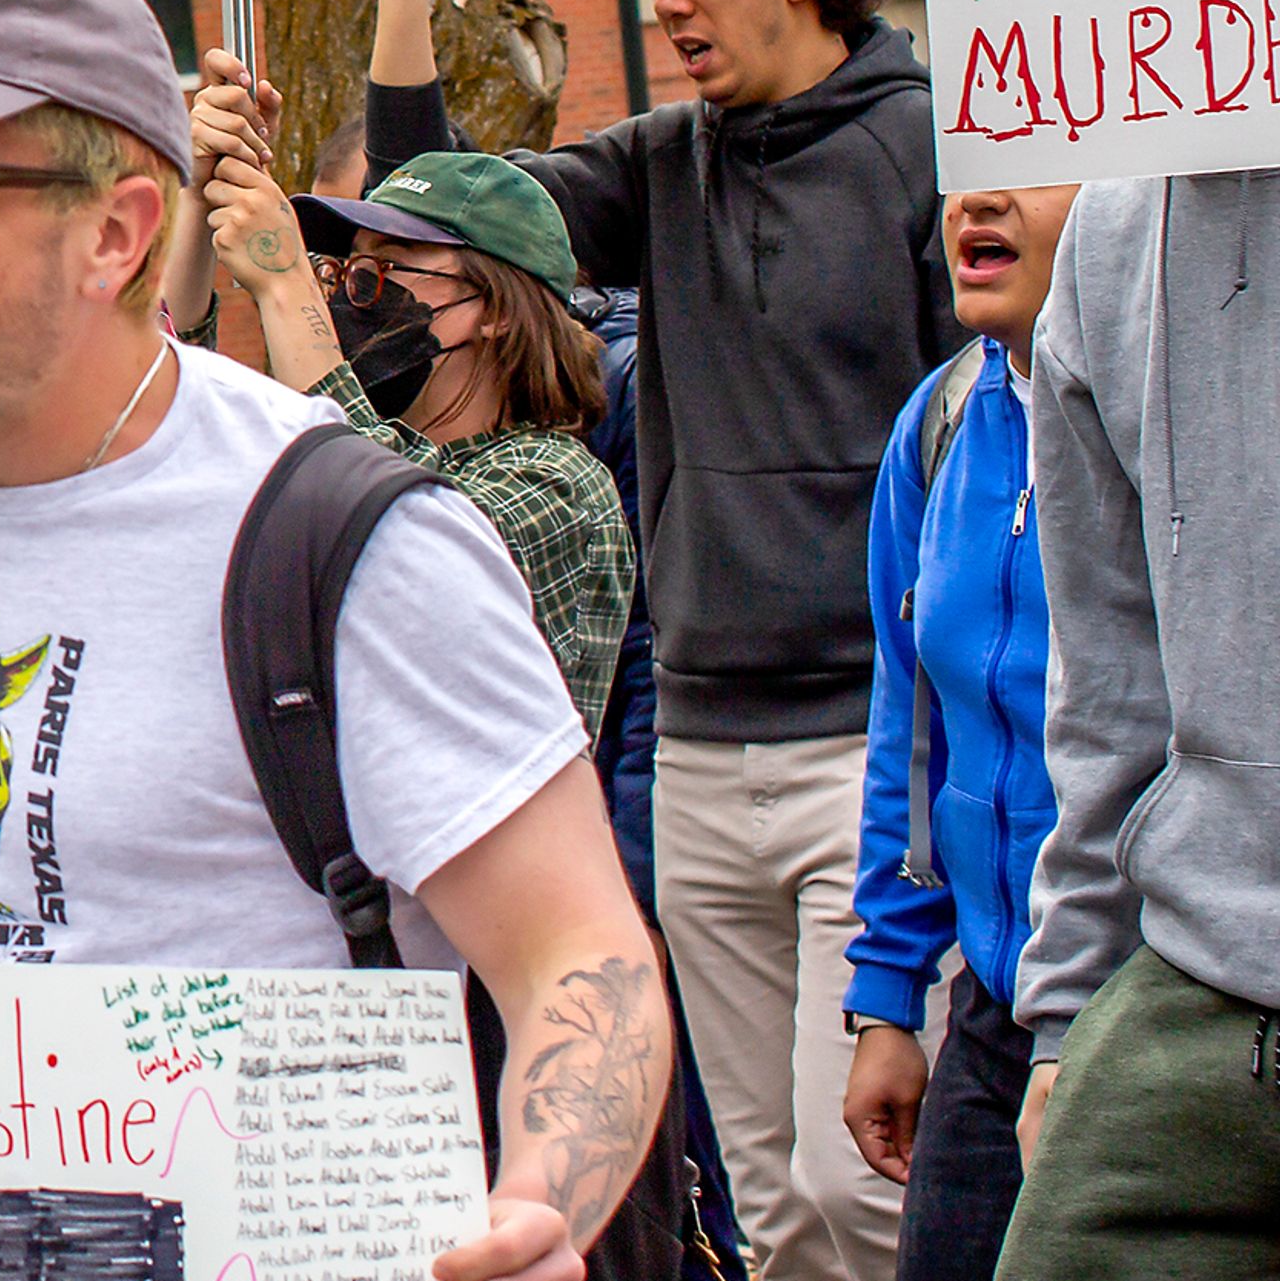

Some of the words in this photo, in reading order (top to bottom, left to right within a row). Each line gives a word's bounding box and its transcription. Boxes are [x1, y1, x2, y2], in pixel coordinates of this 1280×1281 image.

[30, 634, 86, 778] PARIS
[26, 786, 68, 926] TEXAS
[102, 976, 138, 1008] List
